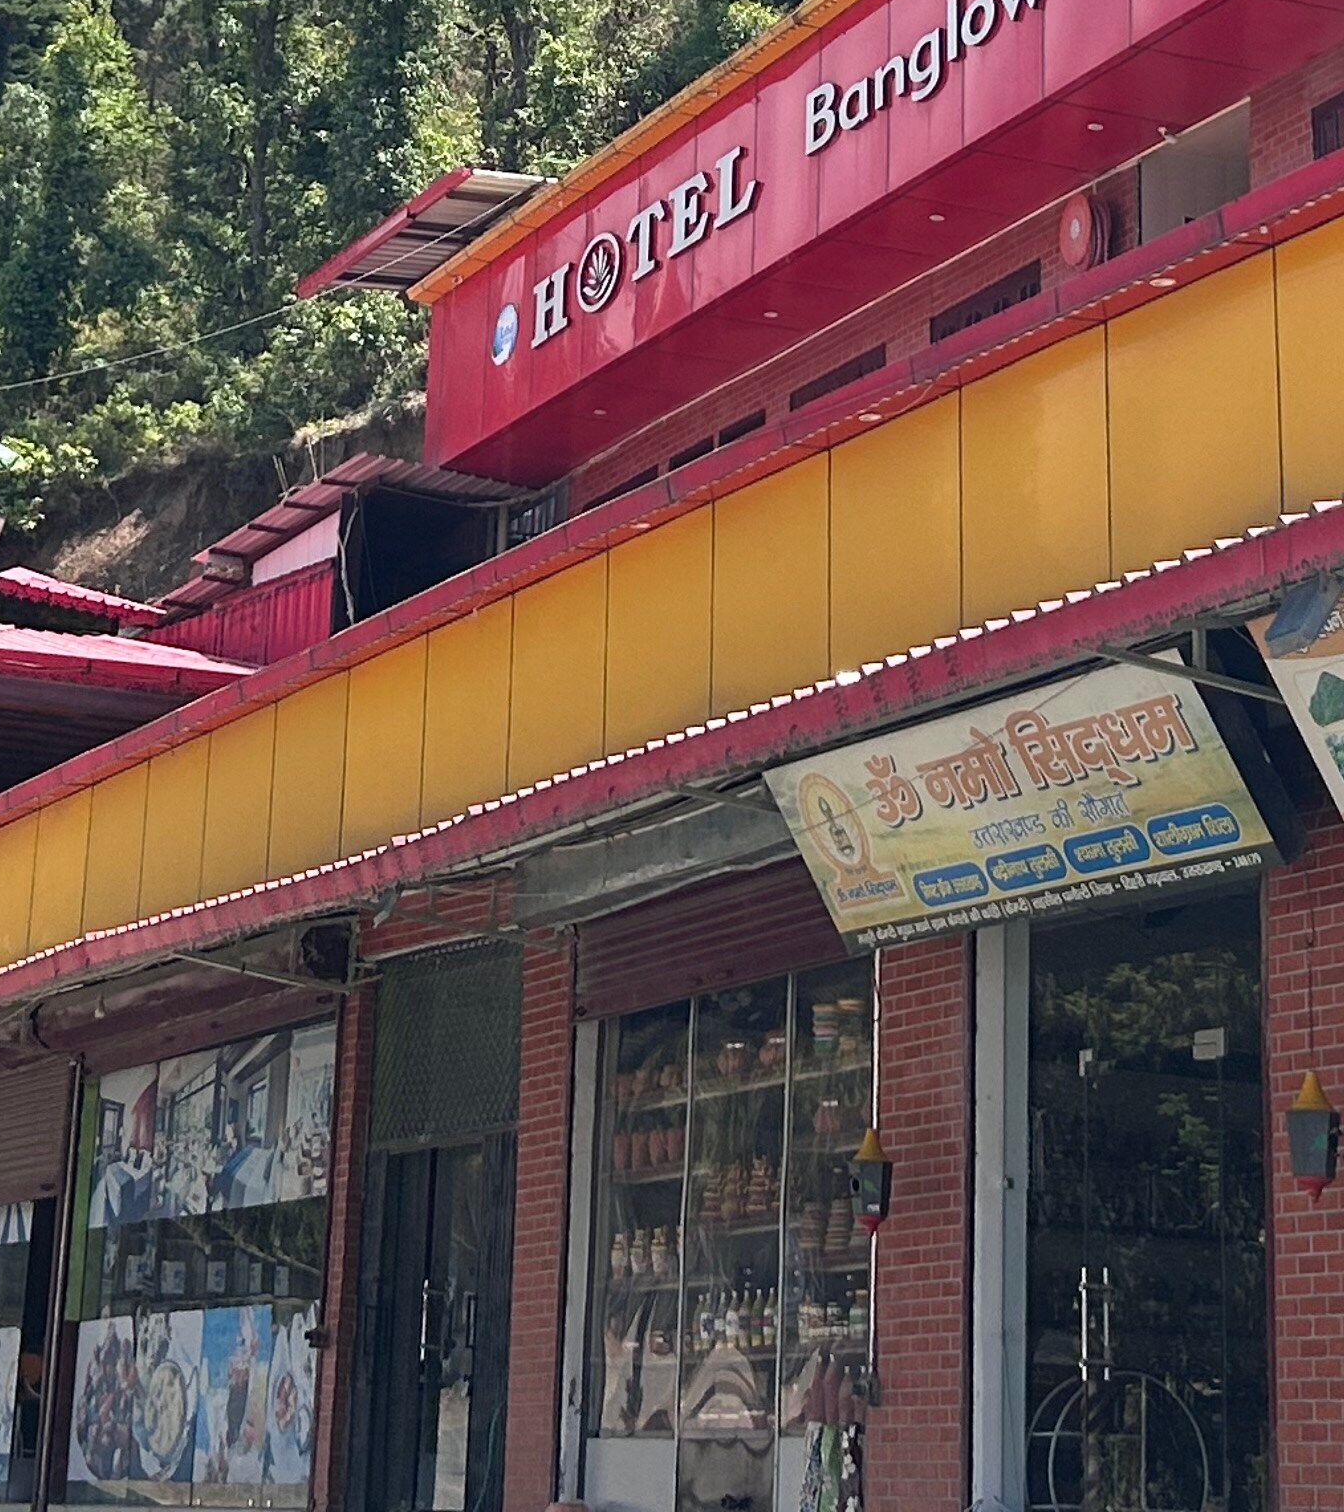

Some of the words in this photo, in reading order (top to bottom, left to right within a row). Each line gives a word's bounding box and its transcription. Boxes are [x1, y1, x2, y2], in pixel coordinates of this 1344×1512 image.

[531, 145, 756, 349] HOTEL
[917, 726, 1011, 809] नमो
[1048, 797, 1075, 828] की
